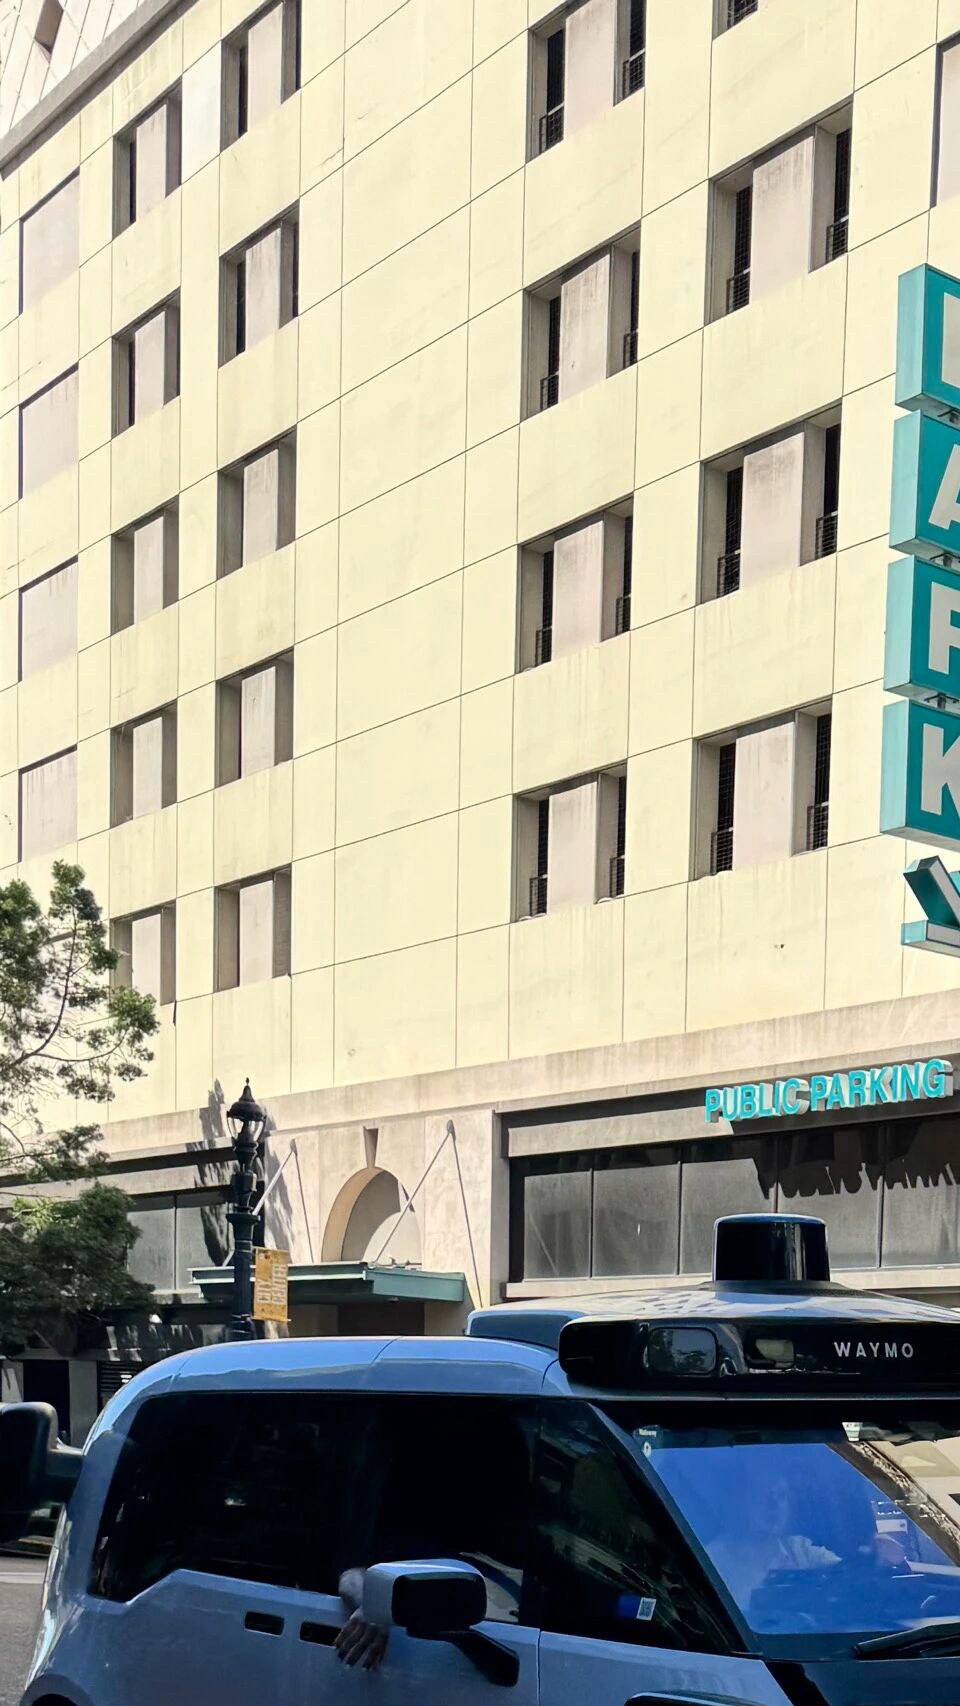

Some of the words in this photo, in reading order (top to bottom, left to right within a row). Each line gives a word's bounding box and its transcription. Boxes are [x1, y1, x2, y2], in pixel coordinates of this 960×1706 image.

[704, 1078, 808, 1123] PUBLIC
[810, 1058, 954, 1112] PARKING
[833, 1341, 914, 1358] WAYMO
